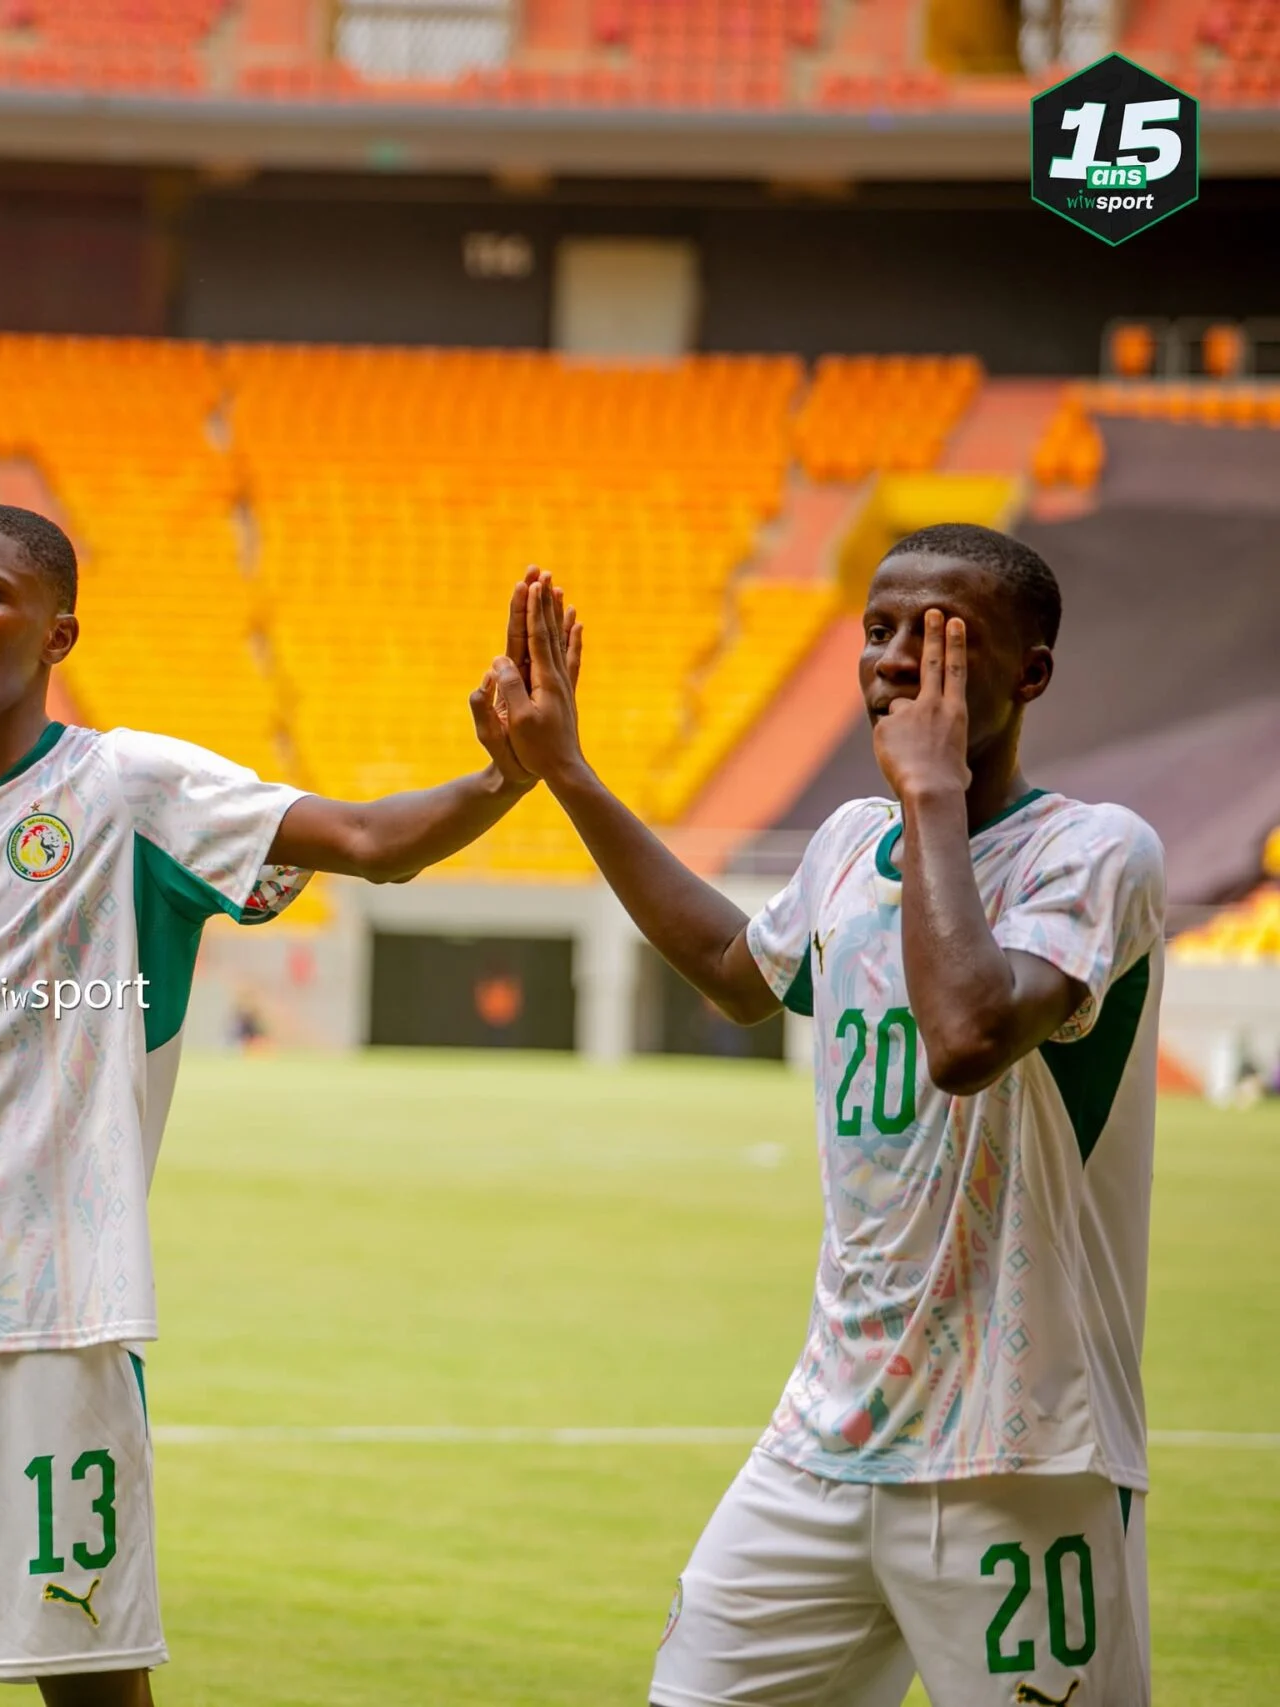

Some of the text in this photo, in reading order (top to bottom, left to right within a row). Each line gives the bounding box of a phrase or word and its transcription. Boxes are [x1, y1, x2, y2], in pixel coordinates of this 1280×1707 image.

[835, 1006, 918, 1137] 20
[24, 1449, 117, 1575] 13
[980, 1533, 1097, 1674] 20
